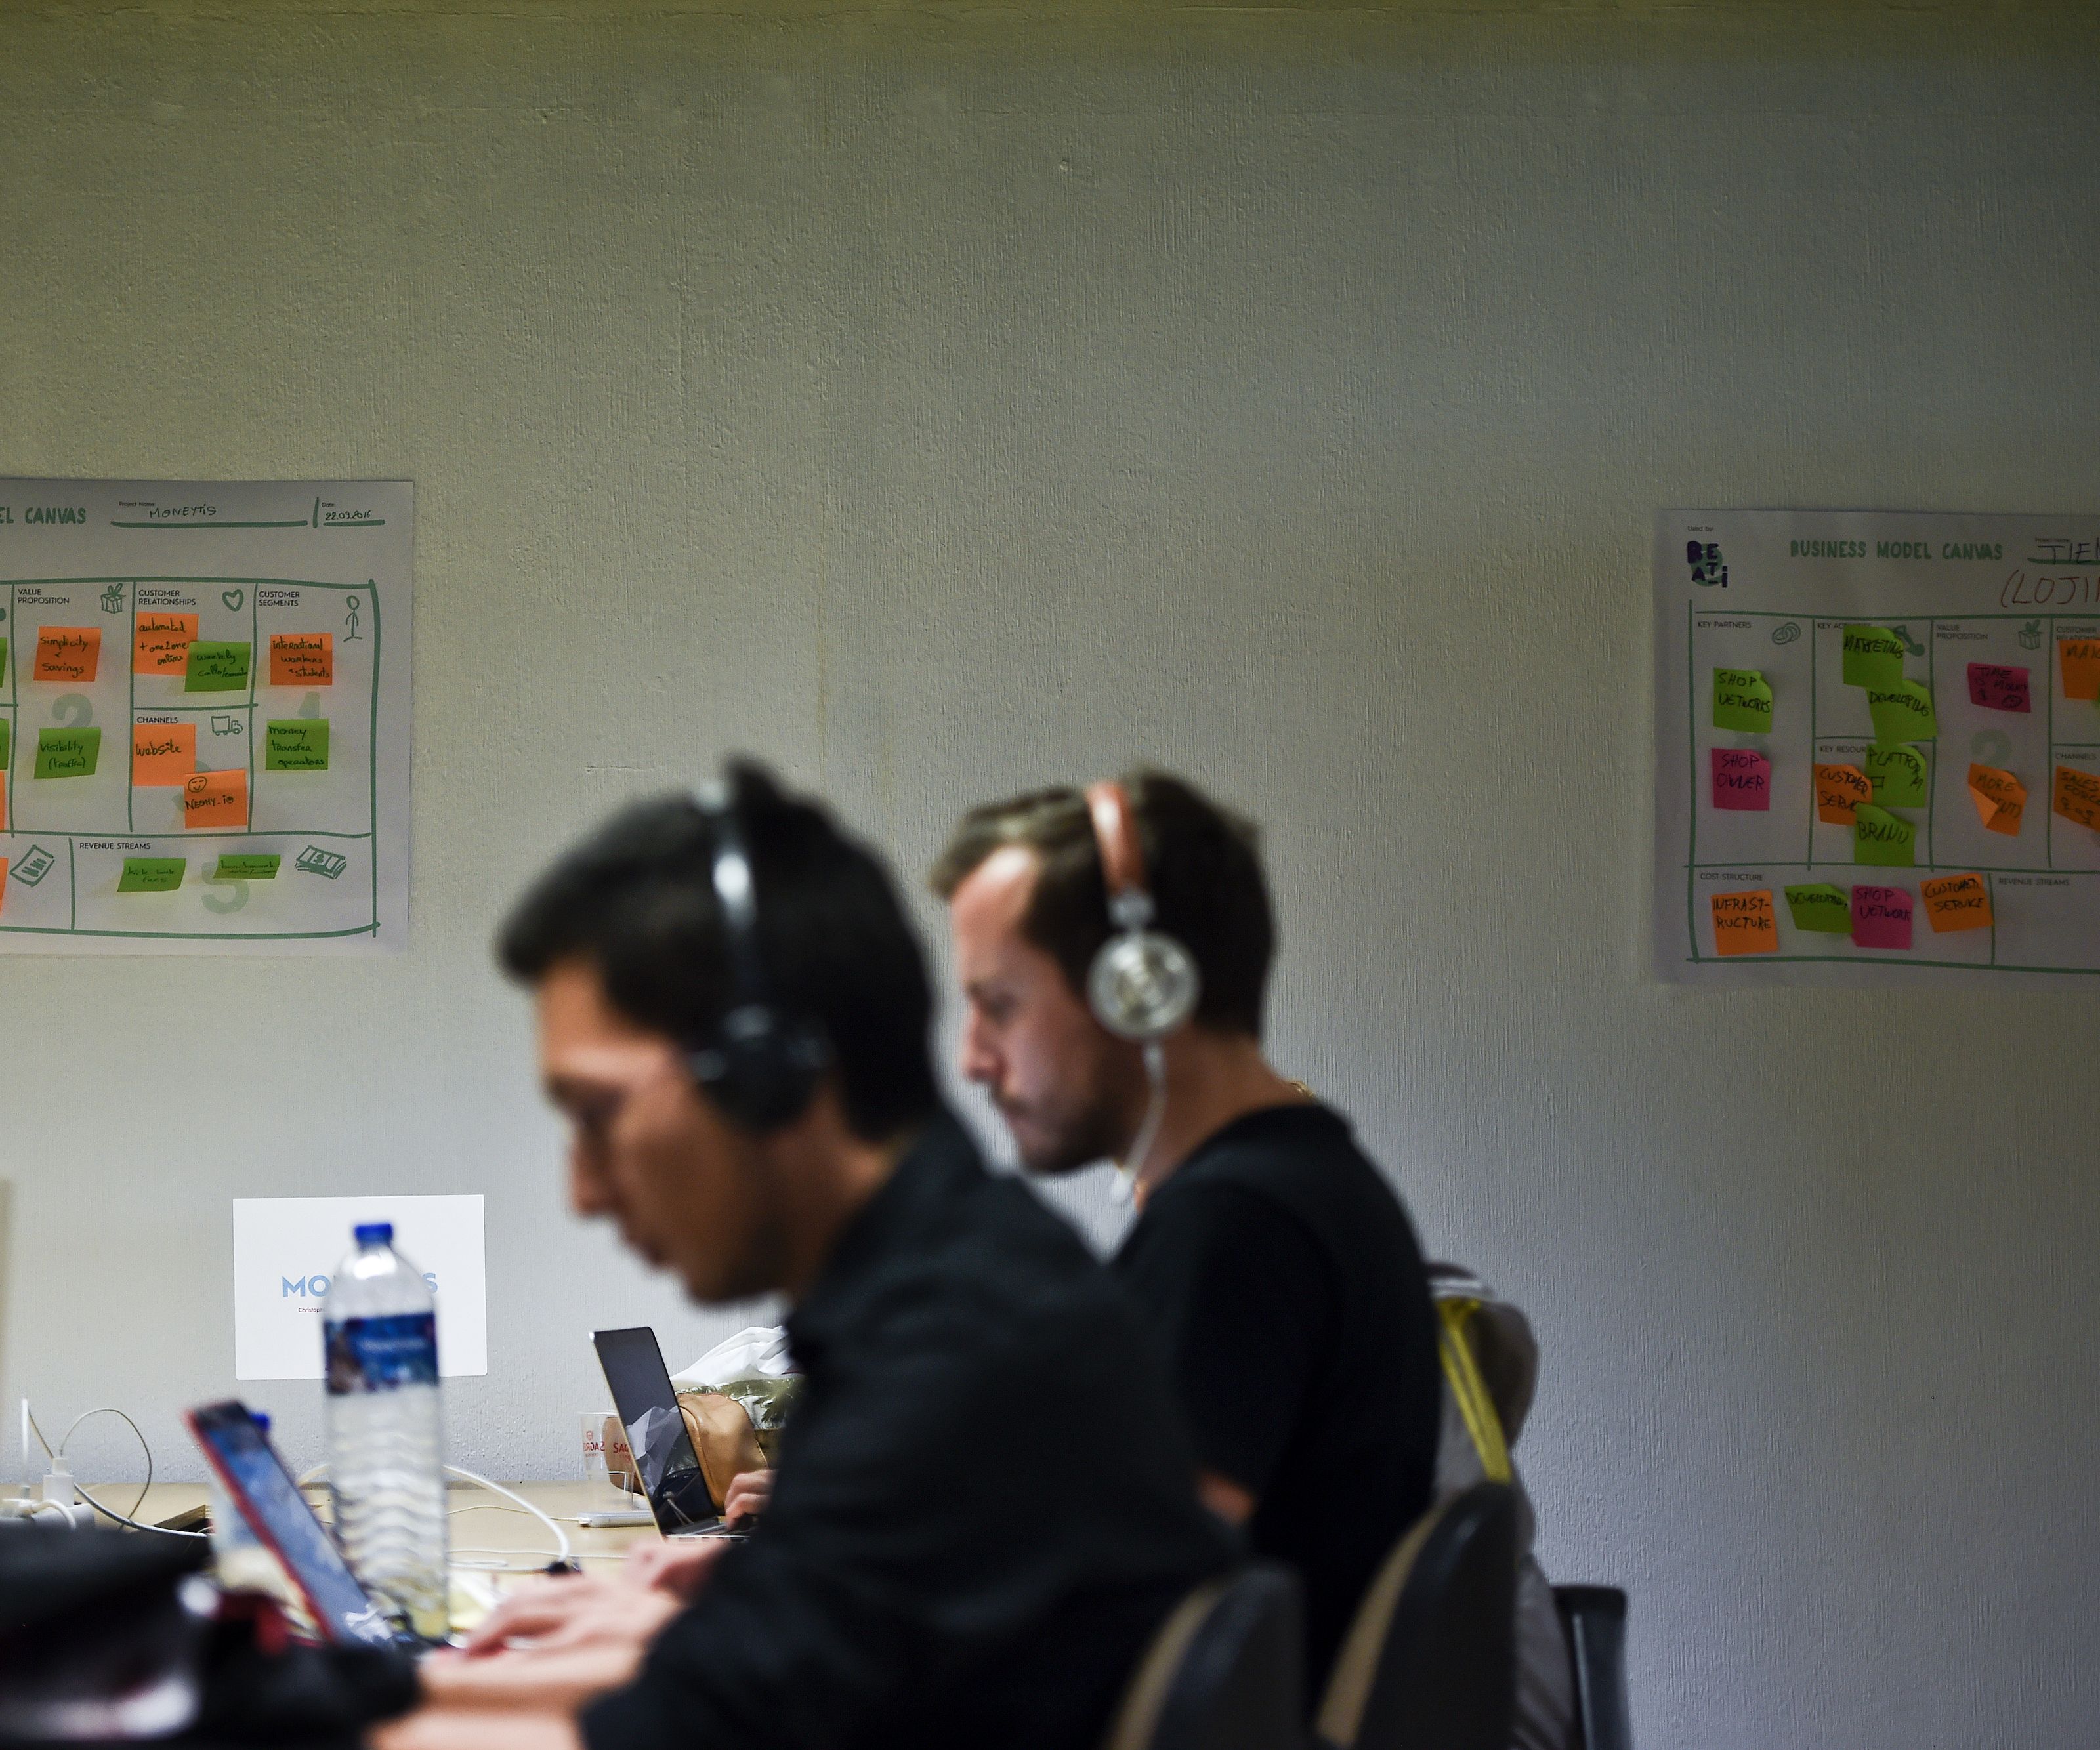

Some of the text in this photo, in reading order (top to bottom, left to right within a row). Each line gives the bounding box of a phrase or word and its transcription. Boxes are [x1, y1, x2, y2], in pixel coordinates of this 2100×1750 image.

[25, 507, 86, 524] CANVAS
[325, 510, 371, 521] 22.09.2016
[1790, 539, 2002, 560] BUSINESS MODEL CANVAS
[1718, 671, 1757, 688] SHOP
[1721, 753, 1760, 769] SHOP
[1855, 887, 1895, 901] SHOP
